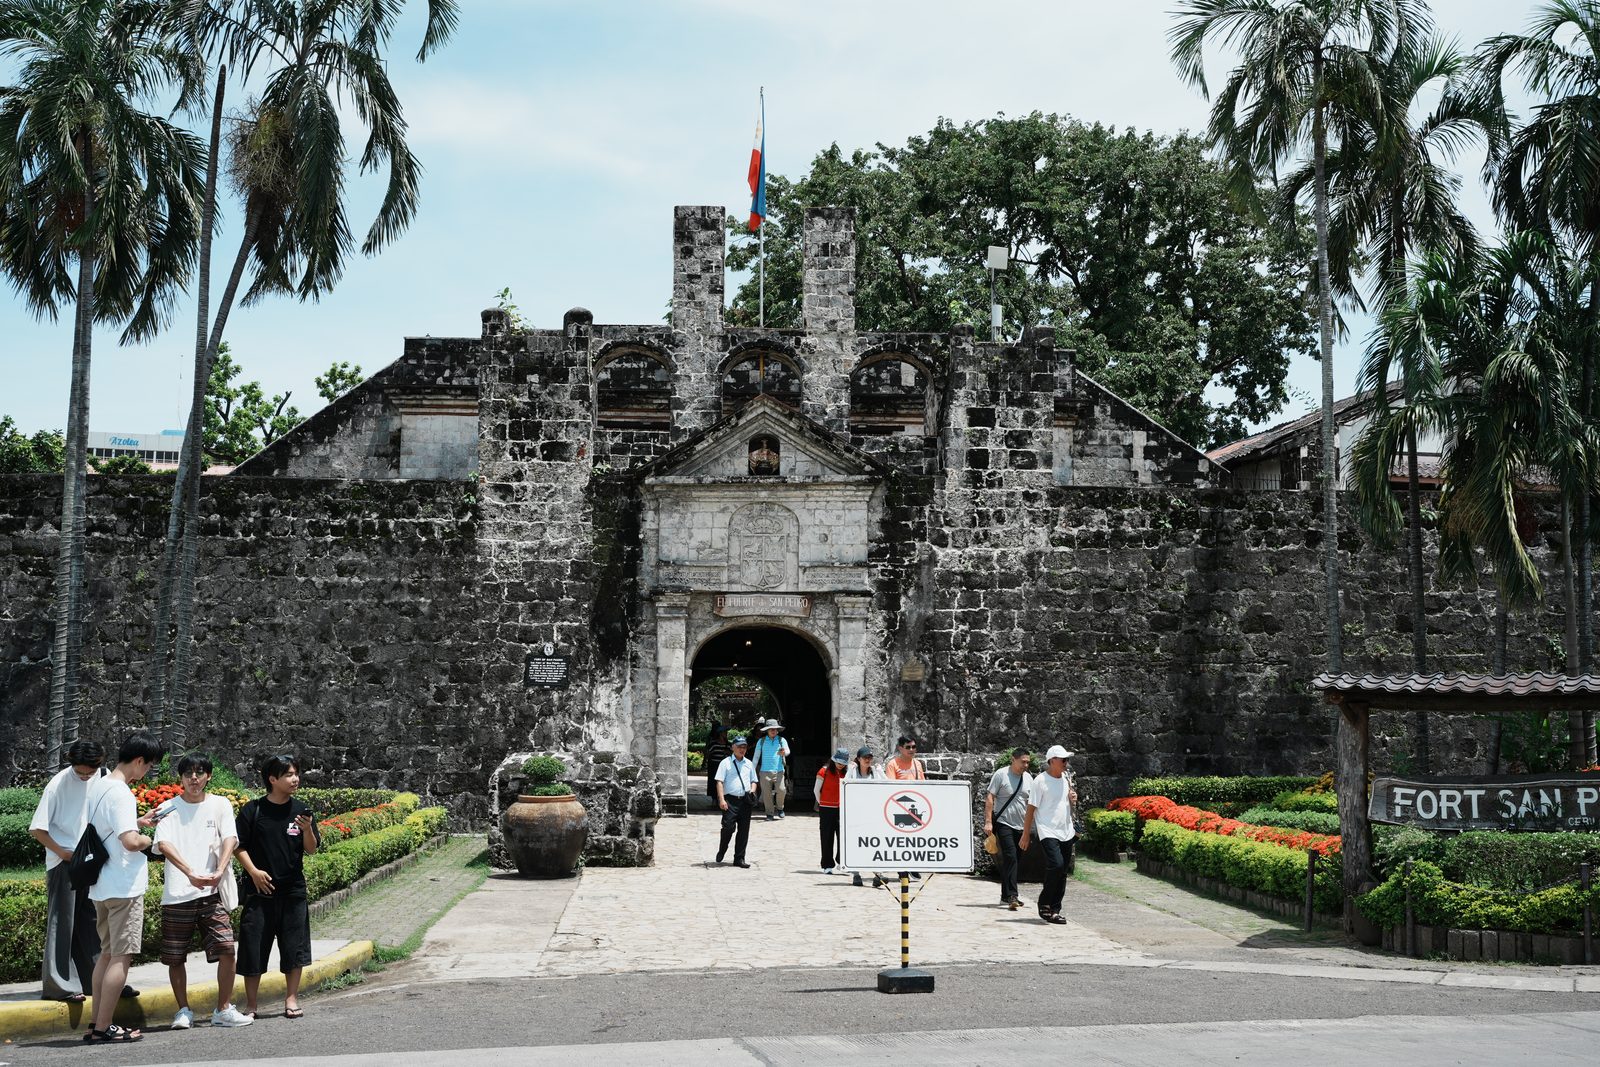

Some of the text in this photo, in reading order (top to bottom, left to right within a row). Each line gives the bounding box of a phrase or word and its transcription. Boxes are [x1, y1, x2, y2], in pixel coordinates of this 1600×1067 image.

[769, 597, 783, 607] SAN
[1393, 787, 1600, 820] FORT SAN P
[858, 836, 959, 848] NO VENDORS
[872, 850, 946, 862] ALLOWED
